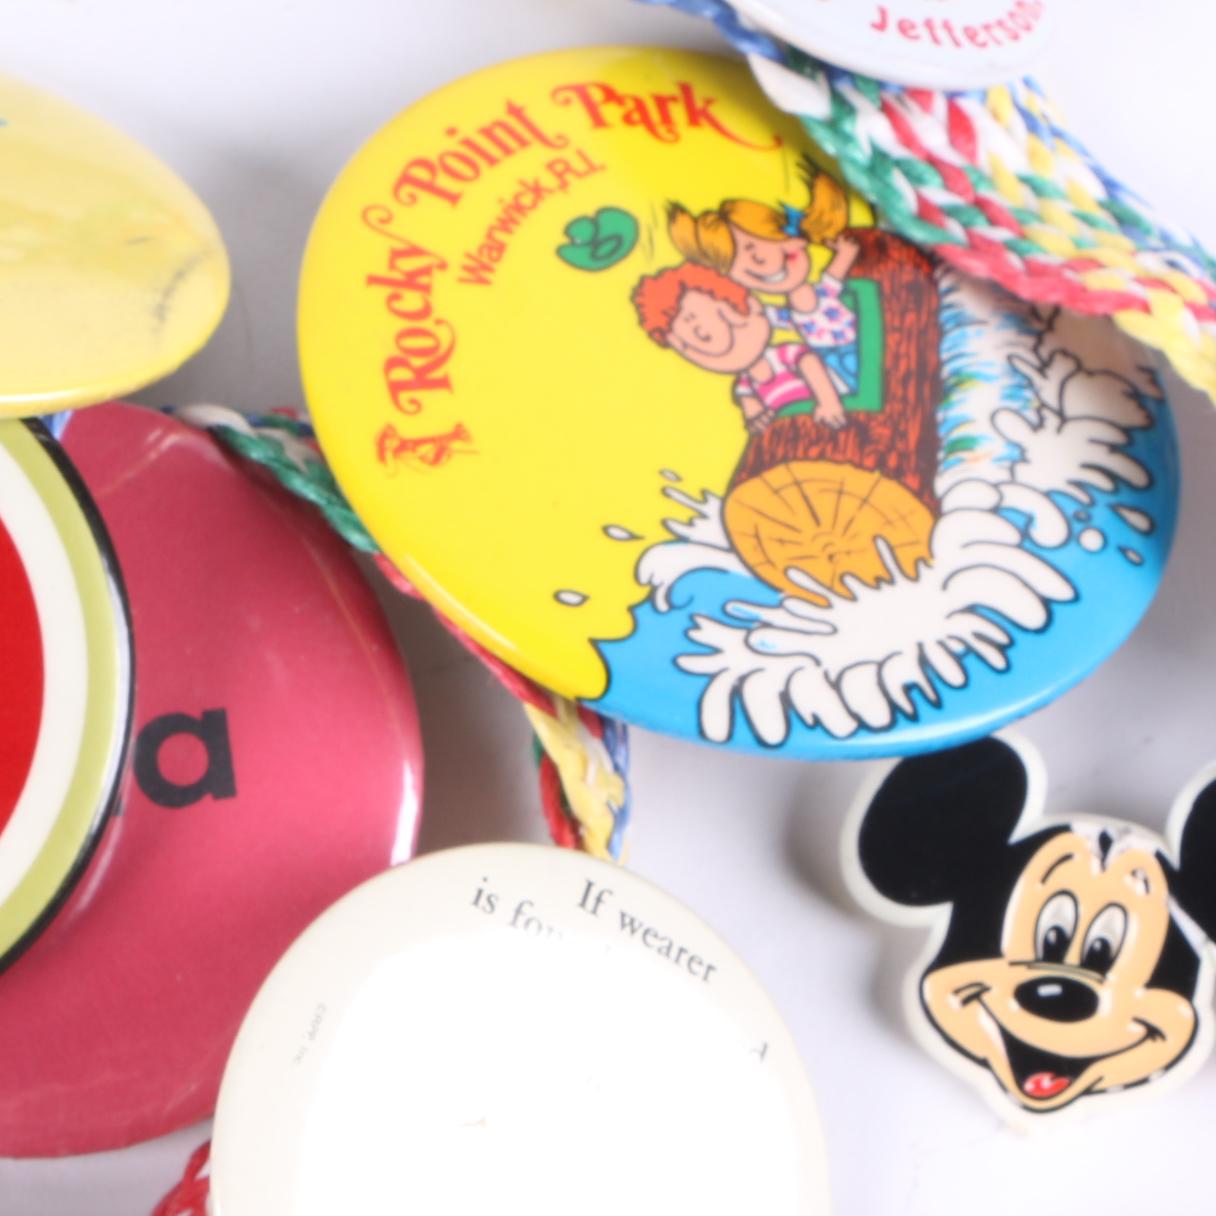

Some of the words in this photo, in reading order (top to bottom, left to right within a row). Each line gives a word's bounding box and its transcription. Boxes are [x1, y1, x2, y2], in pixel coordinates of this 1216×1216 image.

[392, 98, 570, 209] Point
[550, 80, 783, 152] Park
[361, 204, 457, 416] Rocky
[470, 876, 500, 915] is
[577, 877, 614, 917] If
[618, 908, 718, 984] wearer
